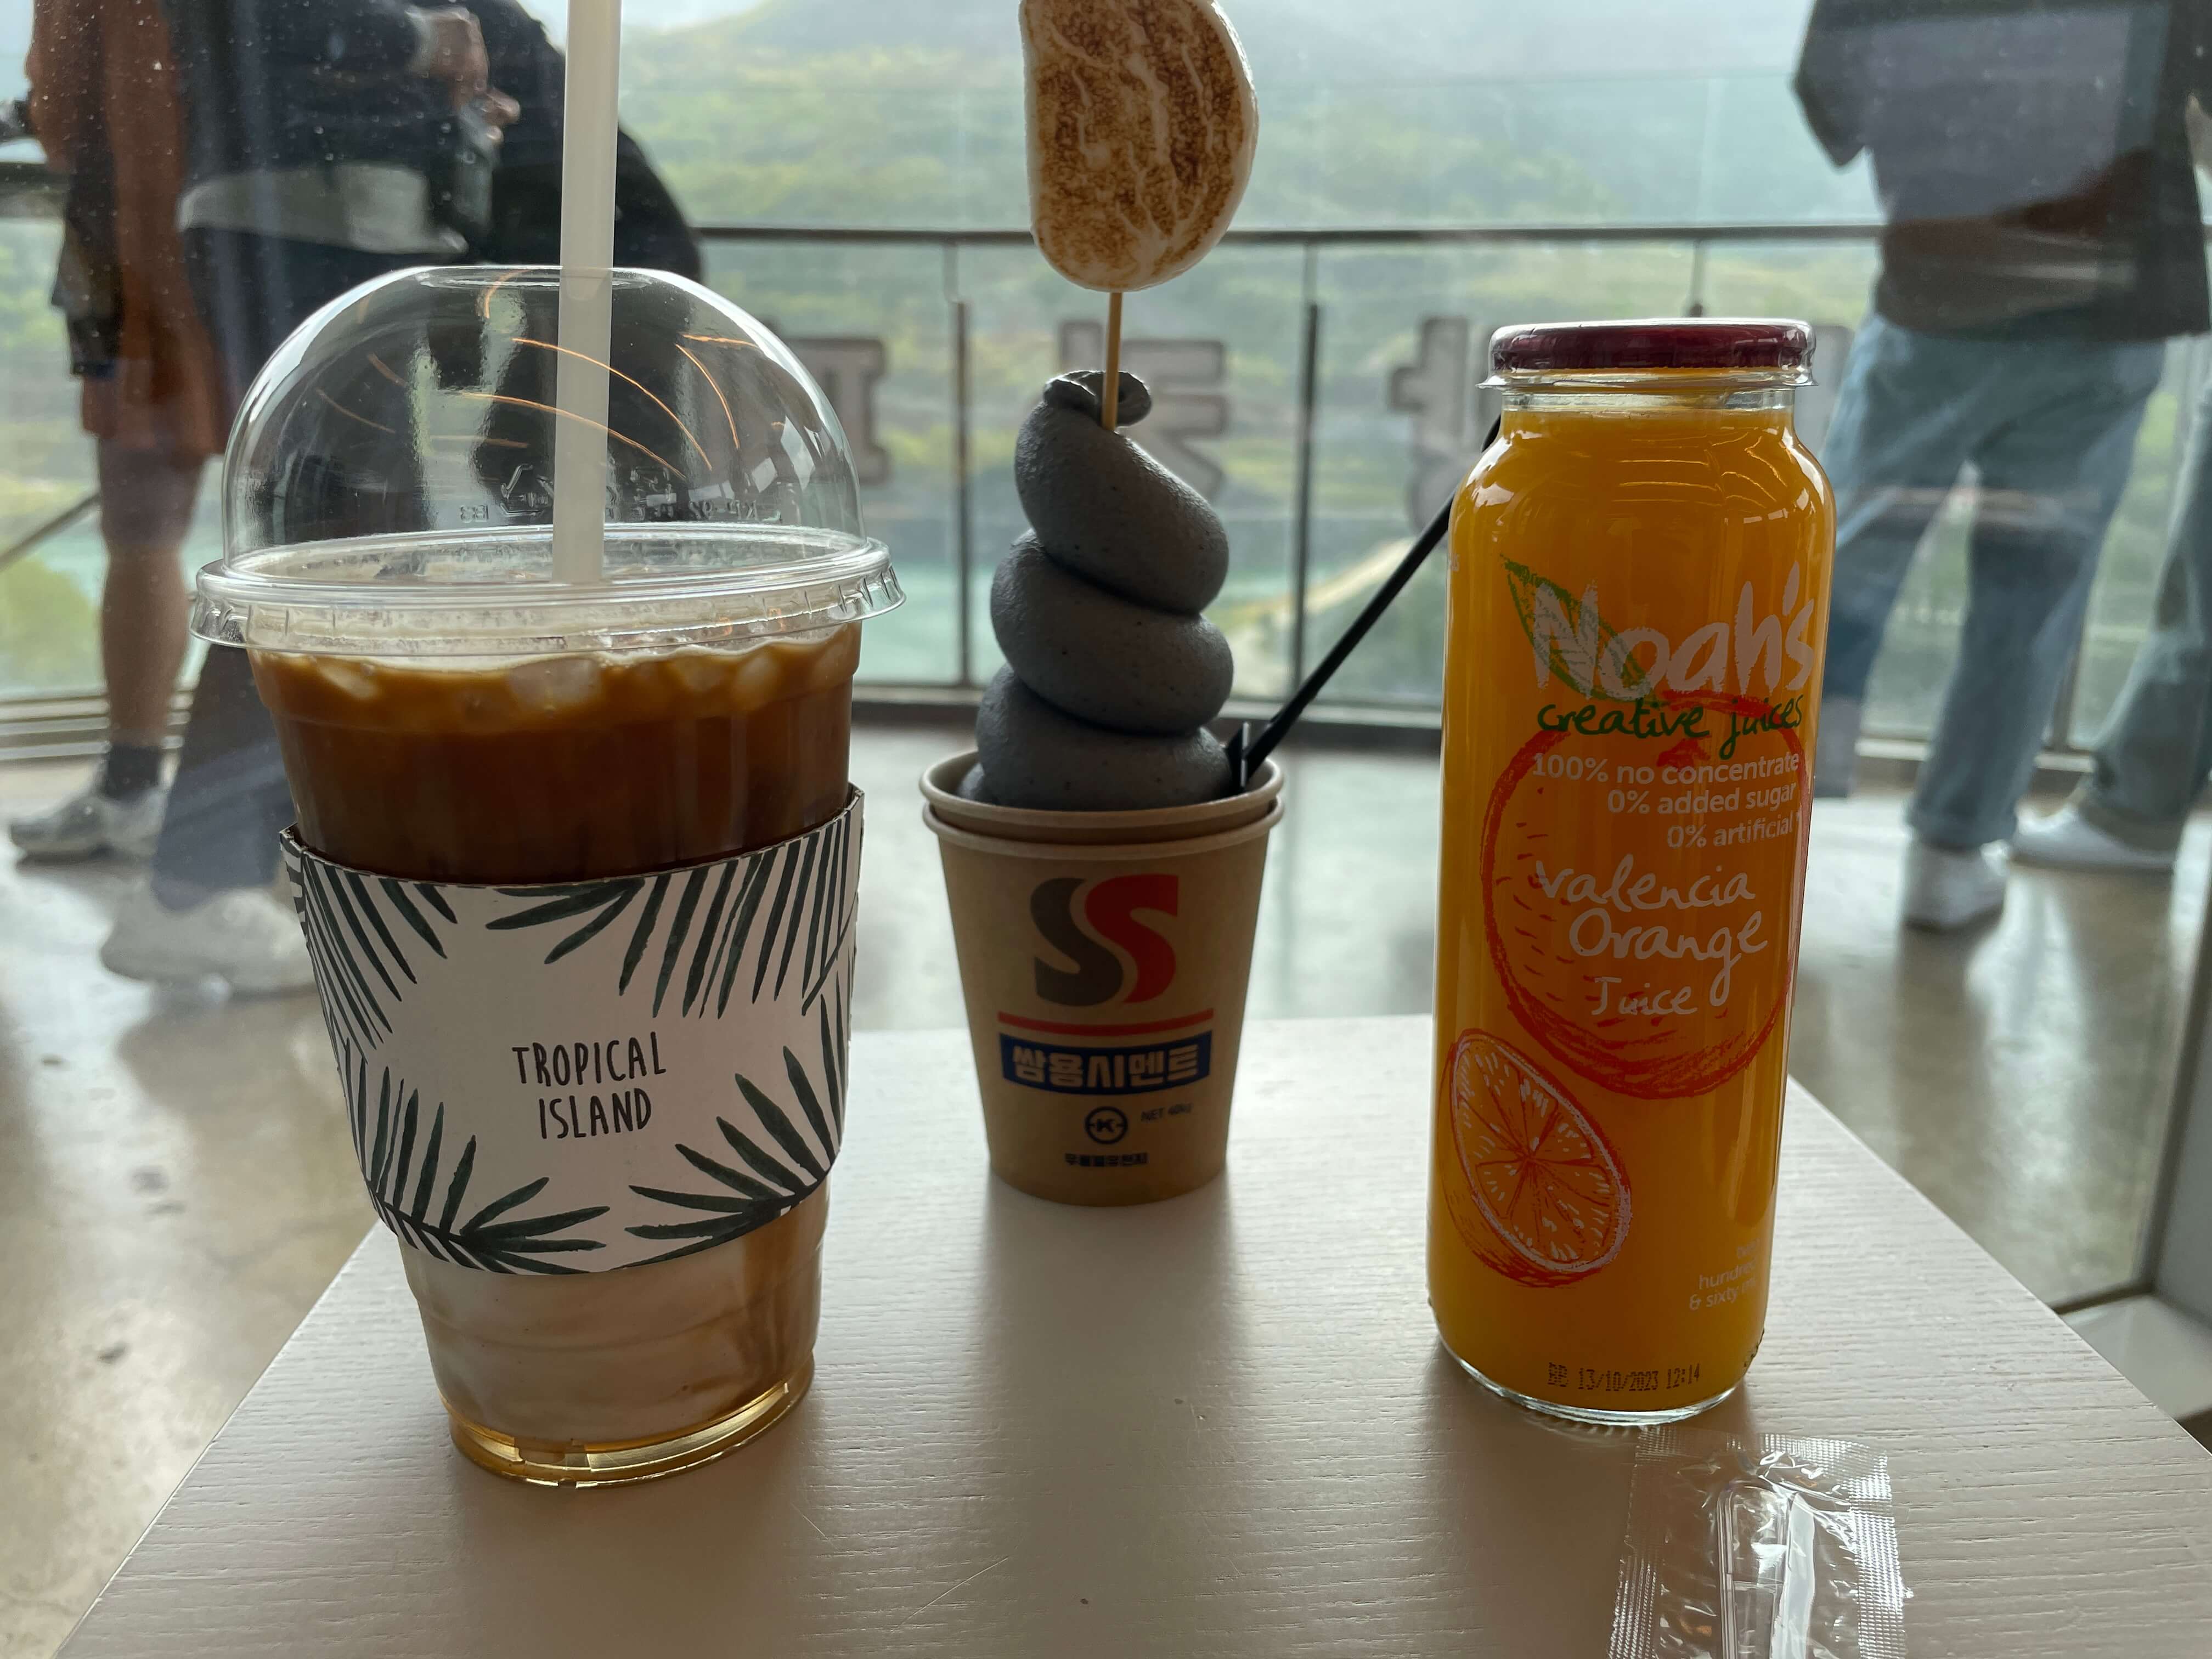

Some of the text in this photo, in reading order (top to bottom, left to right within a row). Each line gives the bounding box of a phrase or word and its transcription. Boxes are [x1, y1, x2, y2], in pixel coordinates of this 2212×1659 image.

[1533, 560, 1814, 701] Noah's
[1538, 694, 1804, 760] creative juices
[1532, 752, 1799, 785] 100% no concentrate
[1607, 782, 1797, 815] 0% added sugar
[1667, 824, 1707, 849] 0%
[1713, 811, 1794, 848] artificial
[1568, 907, 1768, 1007] Orange
[1591, 976, 1699, 1016] Juice
[512, 1031, 667, 1087] TROPICAL
[1012, 1043, 1199, 1089] 쌍용시멘트
[539, 1088, 652, 1139] ISLAND
[1689, 1293, 1702, 1312] &
[1706, 1285, 1739, 1308] sixty
[1578, 1367, 1659, 1392] 13/10/2023
[1666, 1361, 1701, 1390] 12:14
